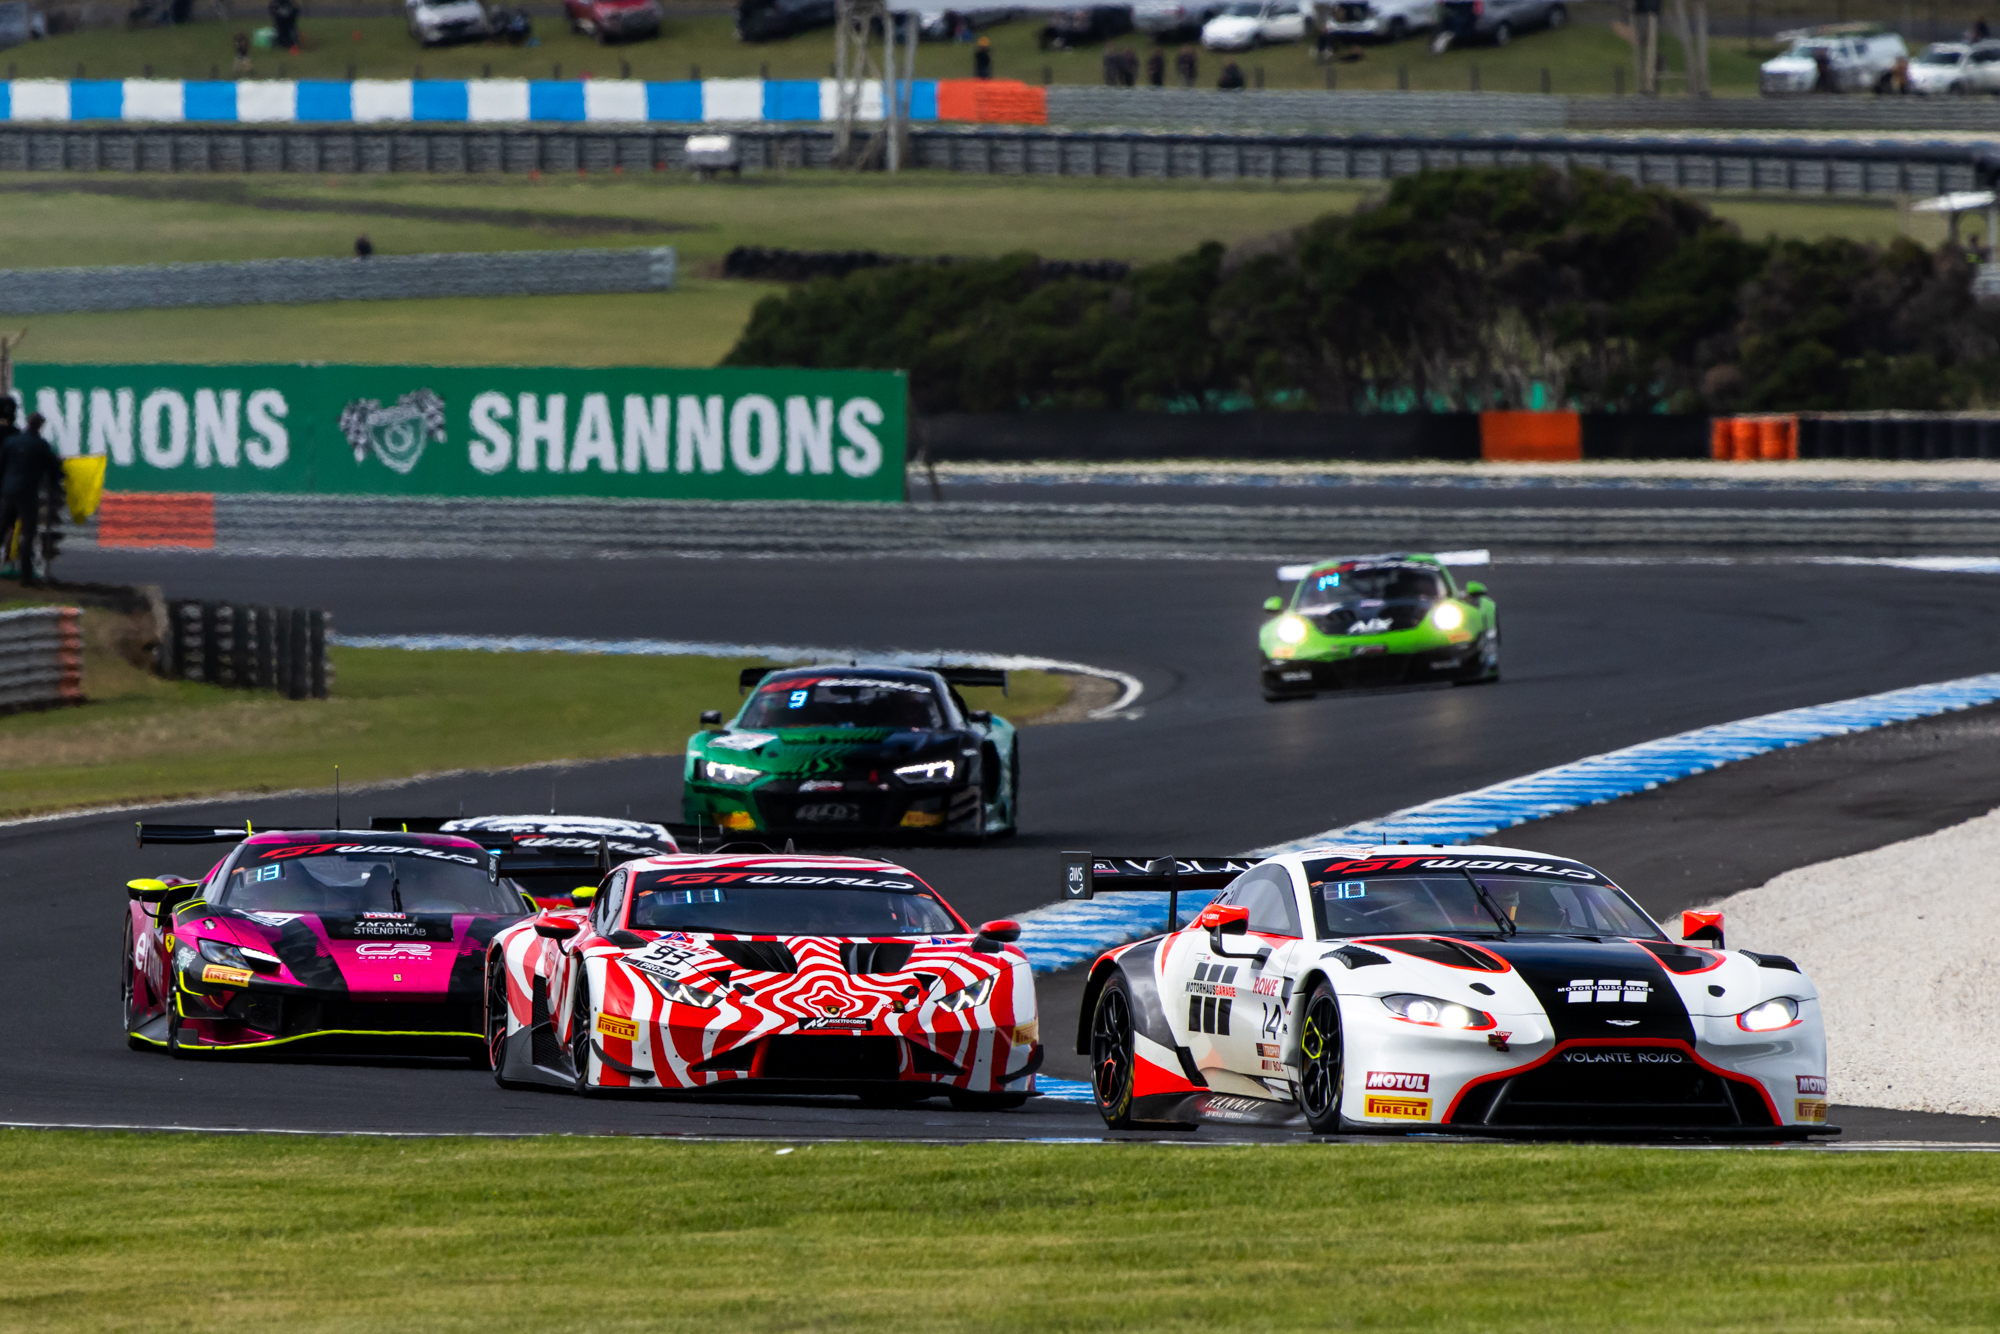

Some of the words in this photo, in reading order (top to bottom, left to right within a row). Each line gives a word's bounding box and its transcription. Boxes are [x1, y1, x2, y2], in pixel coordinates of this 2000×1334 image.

[468, 390, 885, 478] SHANNONS
[788, 689, 809, 709] 9
[259, 843, 361, 860] GT
[335, 845, 478, 865] WORLD
[256, 863, 280, 882] 13
[1069, 866, 1084, 882] aws
[1323, 856, 1447, 875] GT
[1420, 859, 1597, 880] WORLD
[656, 872, 775, 885] GT
[746, 875, 914, 890] WORLD
[1336, 881, 1366, 899] 10
[642, 945, 697, 966] 93
[205, 967, 249, 984] PIRELLI
[1252, 976, 1279, 997] ROWE
[598, 1015, 636, 1037] PIRELLI
[1261, 1001, 1282, 1040] 14
[1562, 1052, 1631, 1063] VOLANTE
[1637, 1053, 1683, 1064] ROSSO
[1367, 1073, 1426, 1090] MOTUL
[1368, 1098, 1428, 1117] PIRELLI
